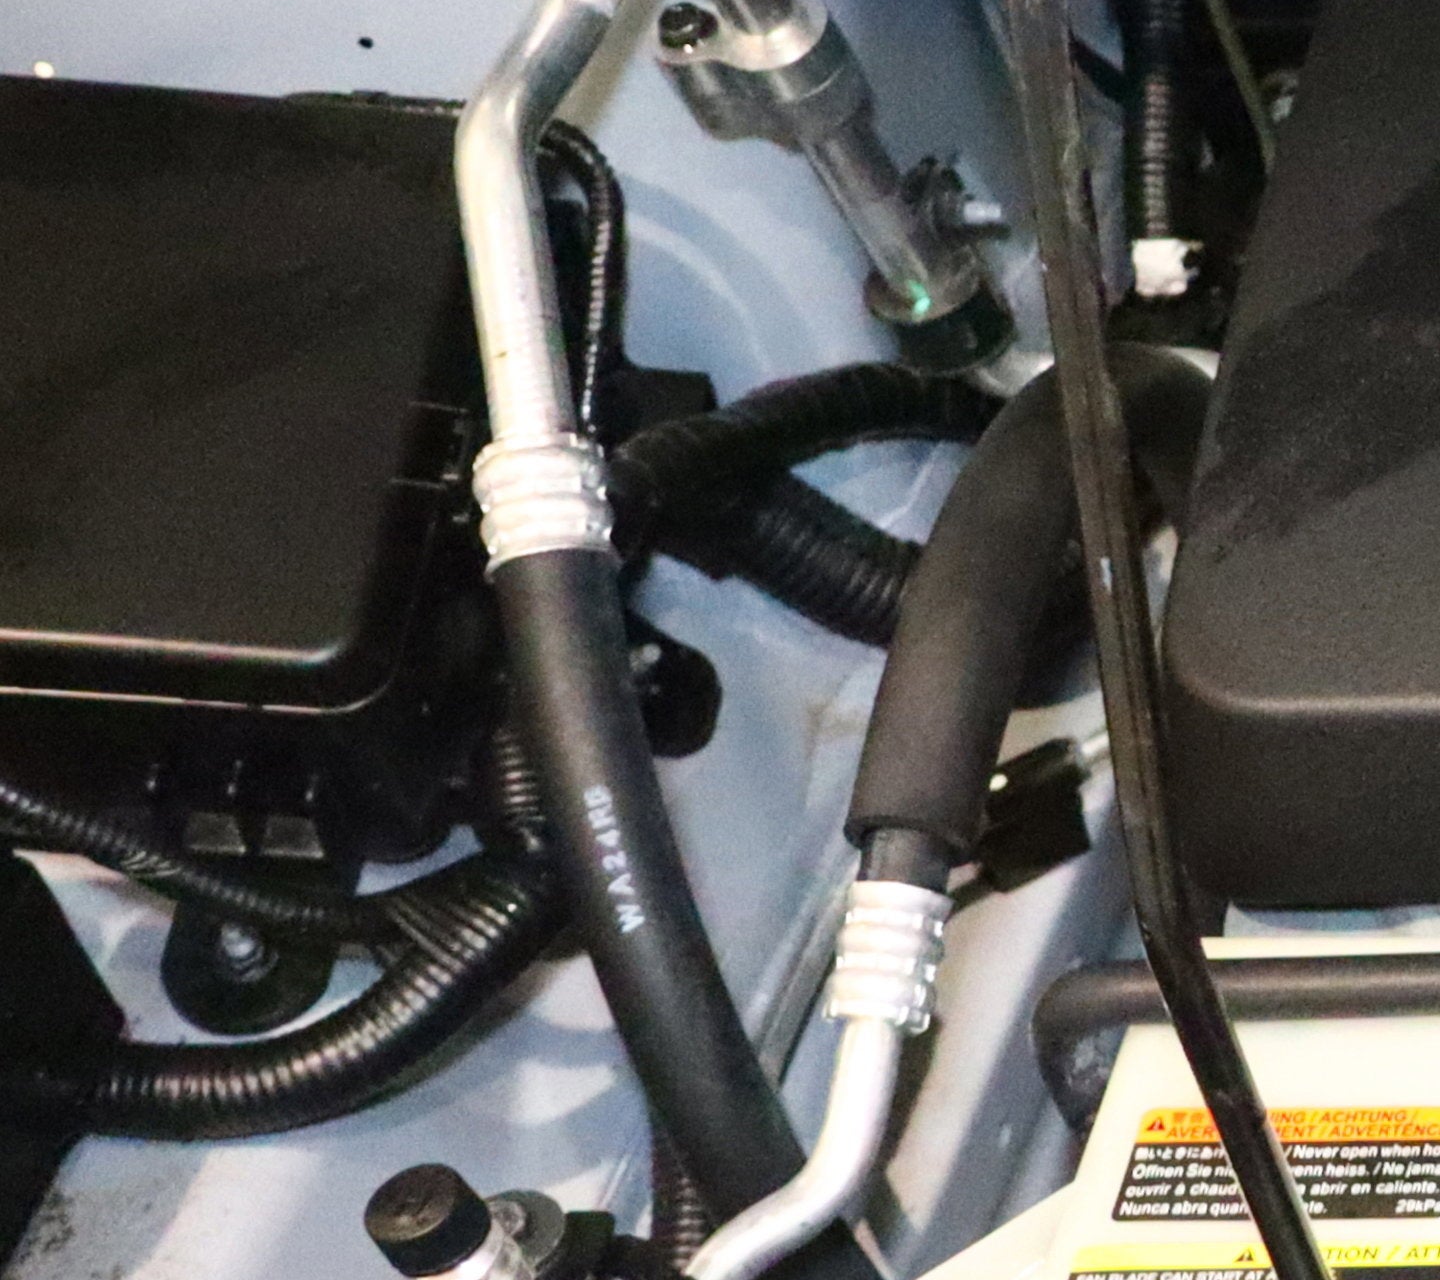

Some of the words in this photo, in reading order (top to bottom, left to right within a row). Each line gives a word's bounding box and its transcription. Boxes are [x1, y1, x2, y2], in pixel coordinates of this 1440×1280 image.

[1293, 1145, 1340, 1159] Never
[1340, 1146, 1378, 1160] open
[1381, 1144, 1420, 1158] when
[1382, 1161, 1405, 1176] Ne
[1125, 1183, 1171, 1198] ouvrir
[1310, 1181, 1348, 1196] abrir
[1350, 1182, 1371, 1195] en
[1119, 1201, 1170, 1216] Nunca
[1171, 1200, 1208, 1216] abra
[1326, 1247, 1379, 1260] TION
